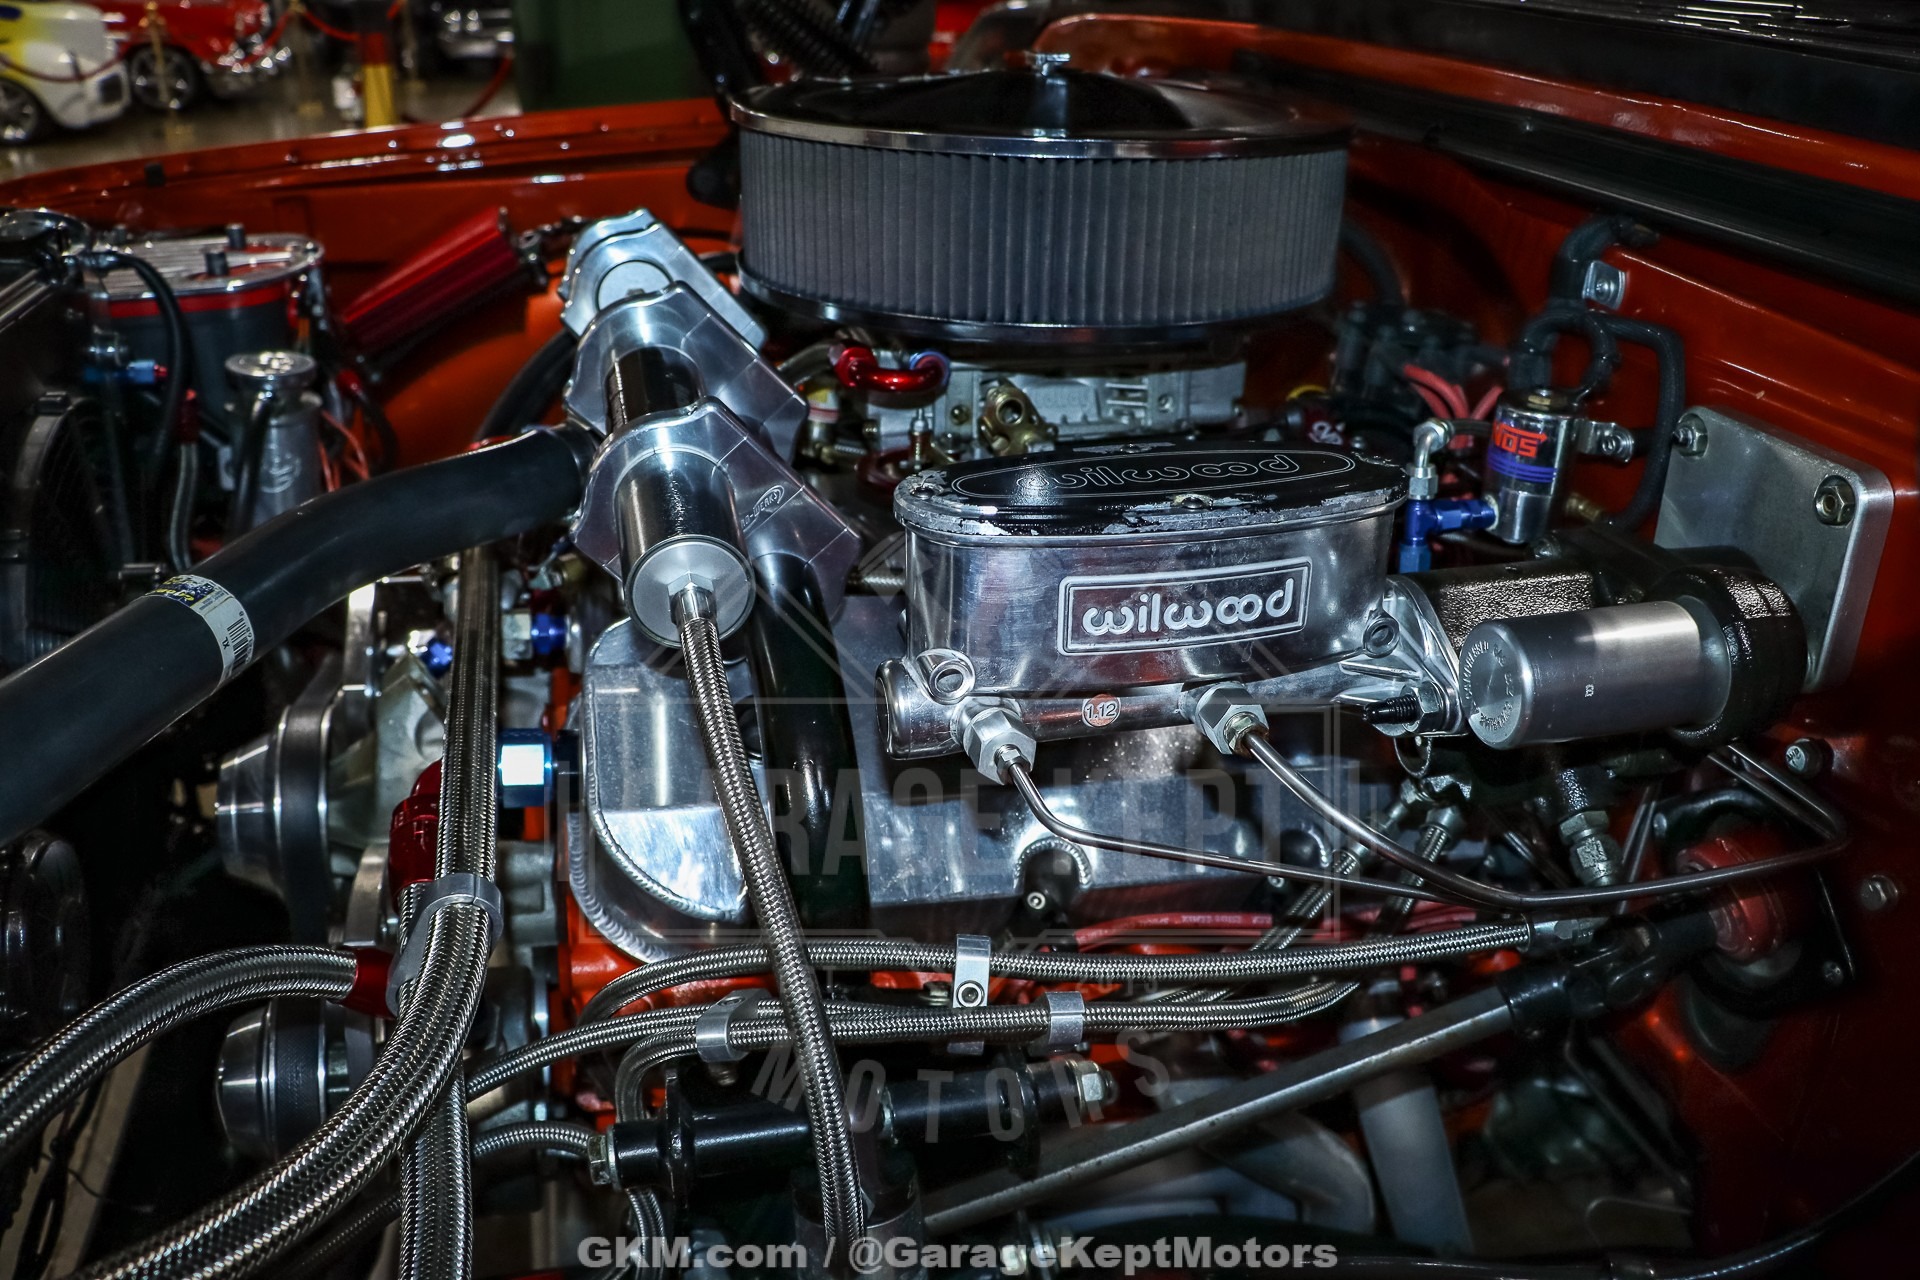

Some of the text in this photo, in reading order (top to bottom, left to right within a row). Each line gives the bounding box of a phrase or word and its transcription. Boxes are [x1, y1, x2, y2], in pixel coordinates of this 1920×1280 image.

[1493, 420, 1547, 458] NOS
[1017, 455, 1299, 489] wilwood
[1082, 578, 1294, 636] wilwood
[1086, 702, 1116, 719] 1.12
